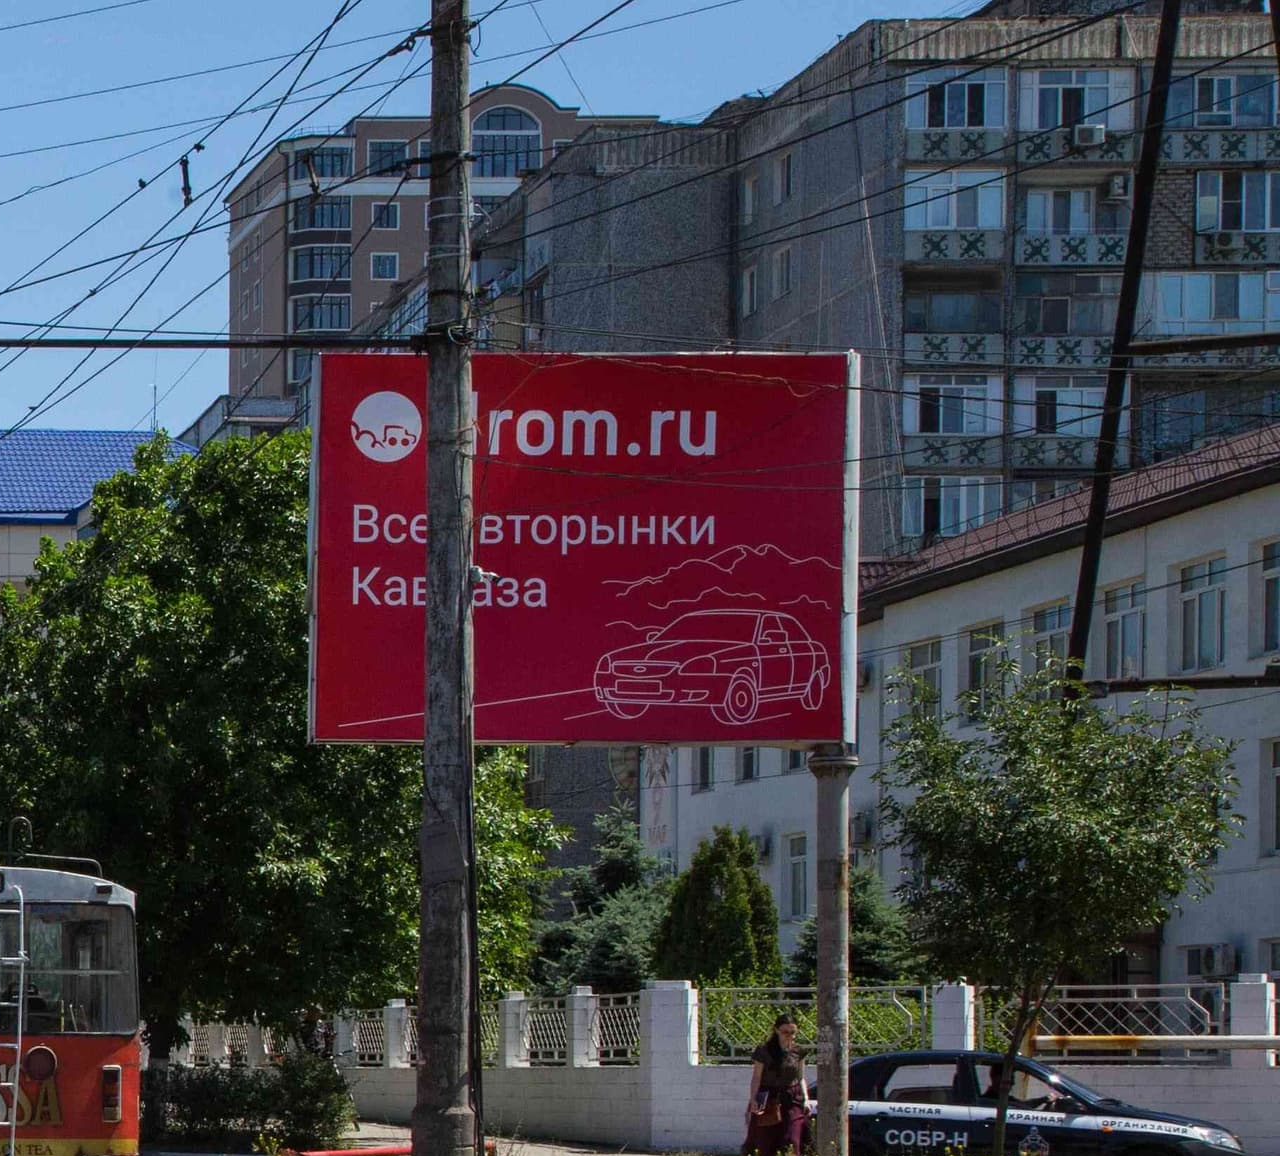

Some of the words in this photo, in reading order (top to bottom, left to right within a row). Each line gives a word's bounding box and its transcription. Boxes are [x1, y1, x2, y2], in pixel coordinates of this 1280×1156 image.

[352, 504, 428, 544] Все
[478, 513, 717, 555] вторынки
[351, 566, 548, 608] Каваза
[889, 1105, 941, 1115] ЧАСТНАЯ
[1007, 1112, 1065, 1125] ХРАННАЯ
[1101, 1119, 1188, 1135] ОРГАНИЗАЦИЯ
[26, 1144, 53, 1156] TEA
[885, 1129, 968, 1147] СОБР-Н
